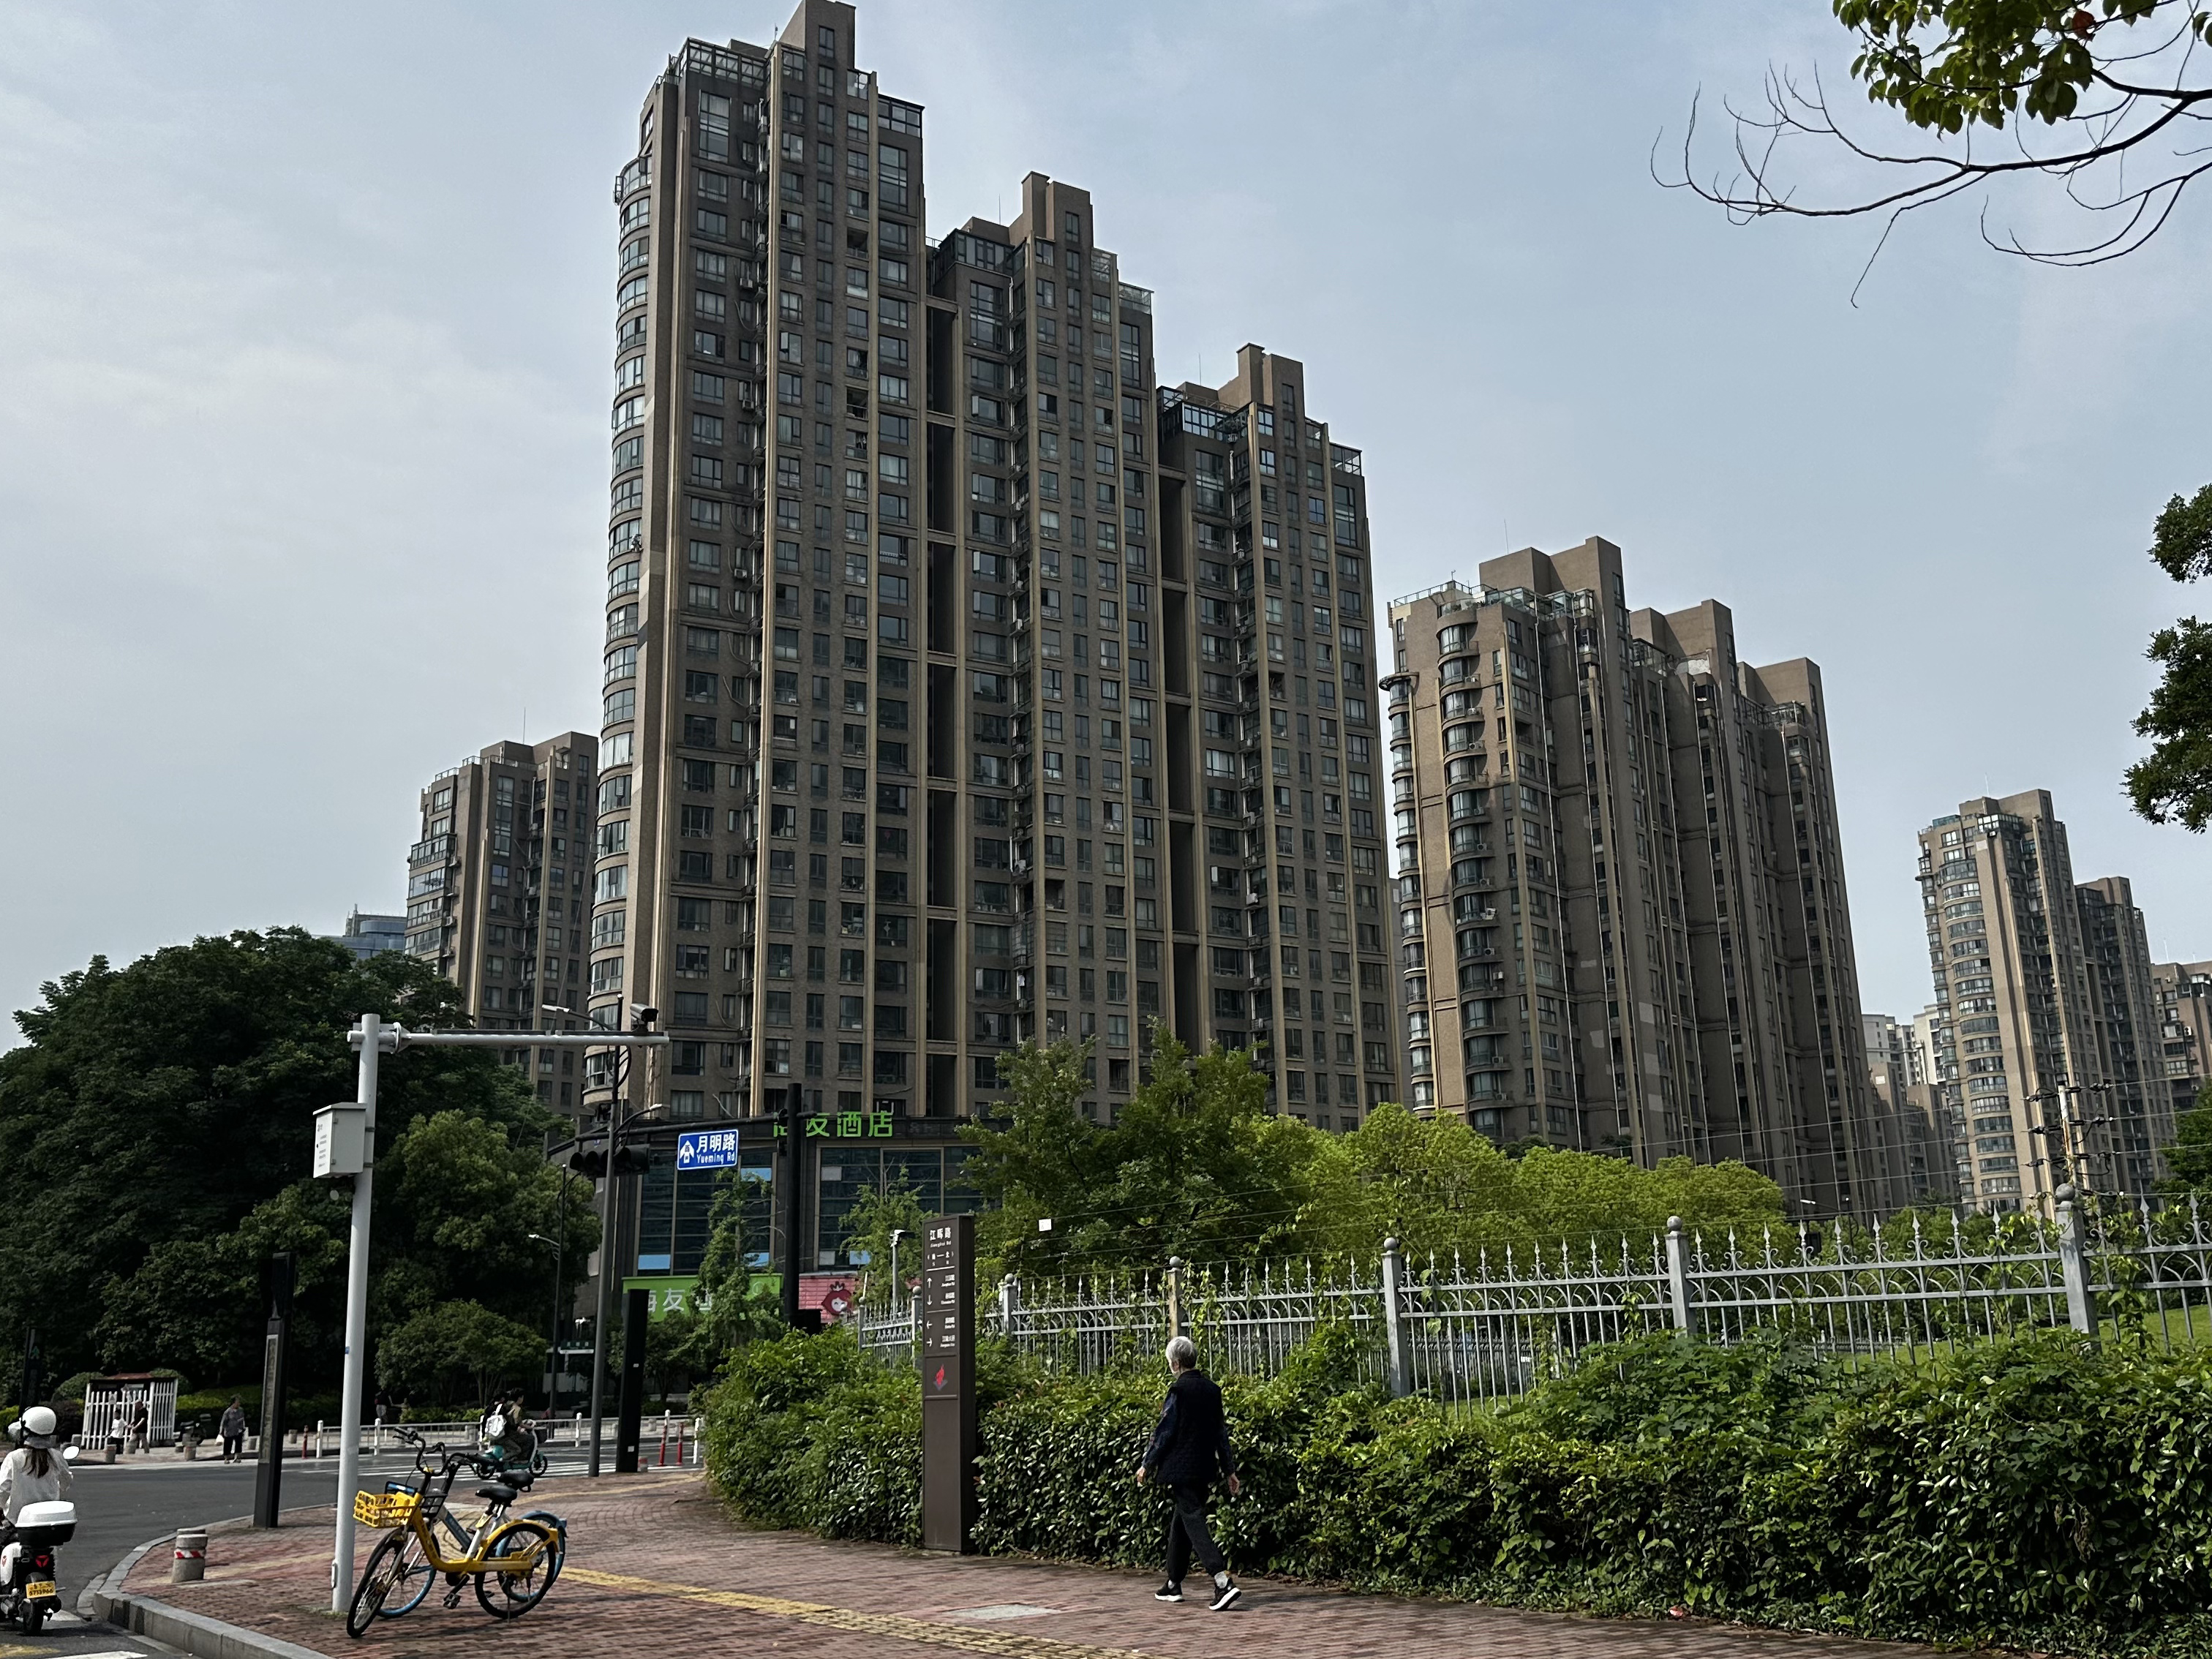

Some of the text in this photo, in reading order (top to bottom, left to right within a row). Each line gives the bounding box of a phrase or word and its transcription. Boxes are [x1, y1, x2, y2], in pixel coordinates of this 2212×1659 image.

[696, 1133, 735, 1153] 月明路
[696, 1153, 724, 1165] Yueming
[726, 1151, 735, 1162] Rd
